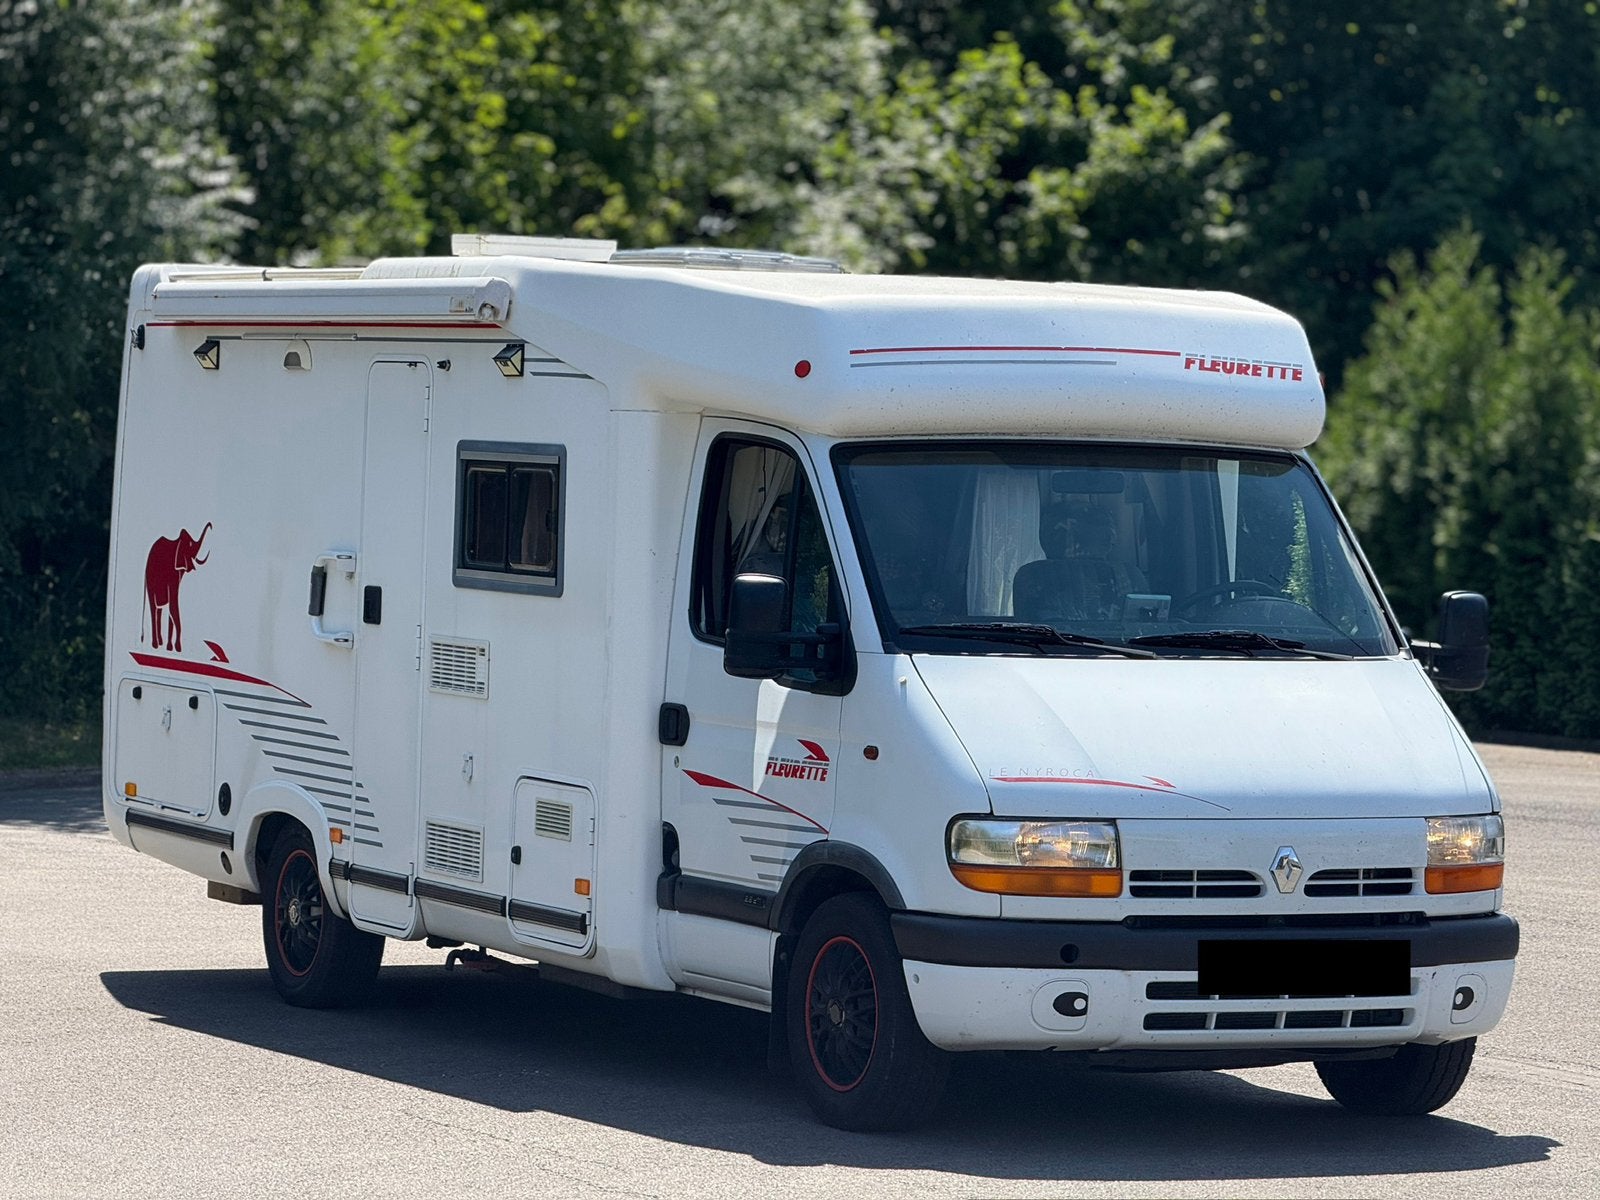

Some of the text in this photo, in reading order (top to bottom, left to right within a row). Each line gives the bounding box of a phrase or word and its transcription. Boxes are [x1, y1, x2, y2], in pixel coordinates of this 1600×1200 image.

[1184, 357, 1303, 381] FLEURETTE
[765, 761, 828, 782] FLEURETTE
[989, 767, 1095, 778] LE NYROCA
